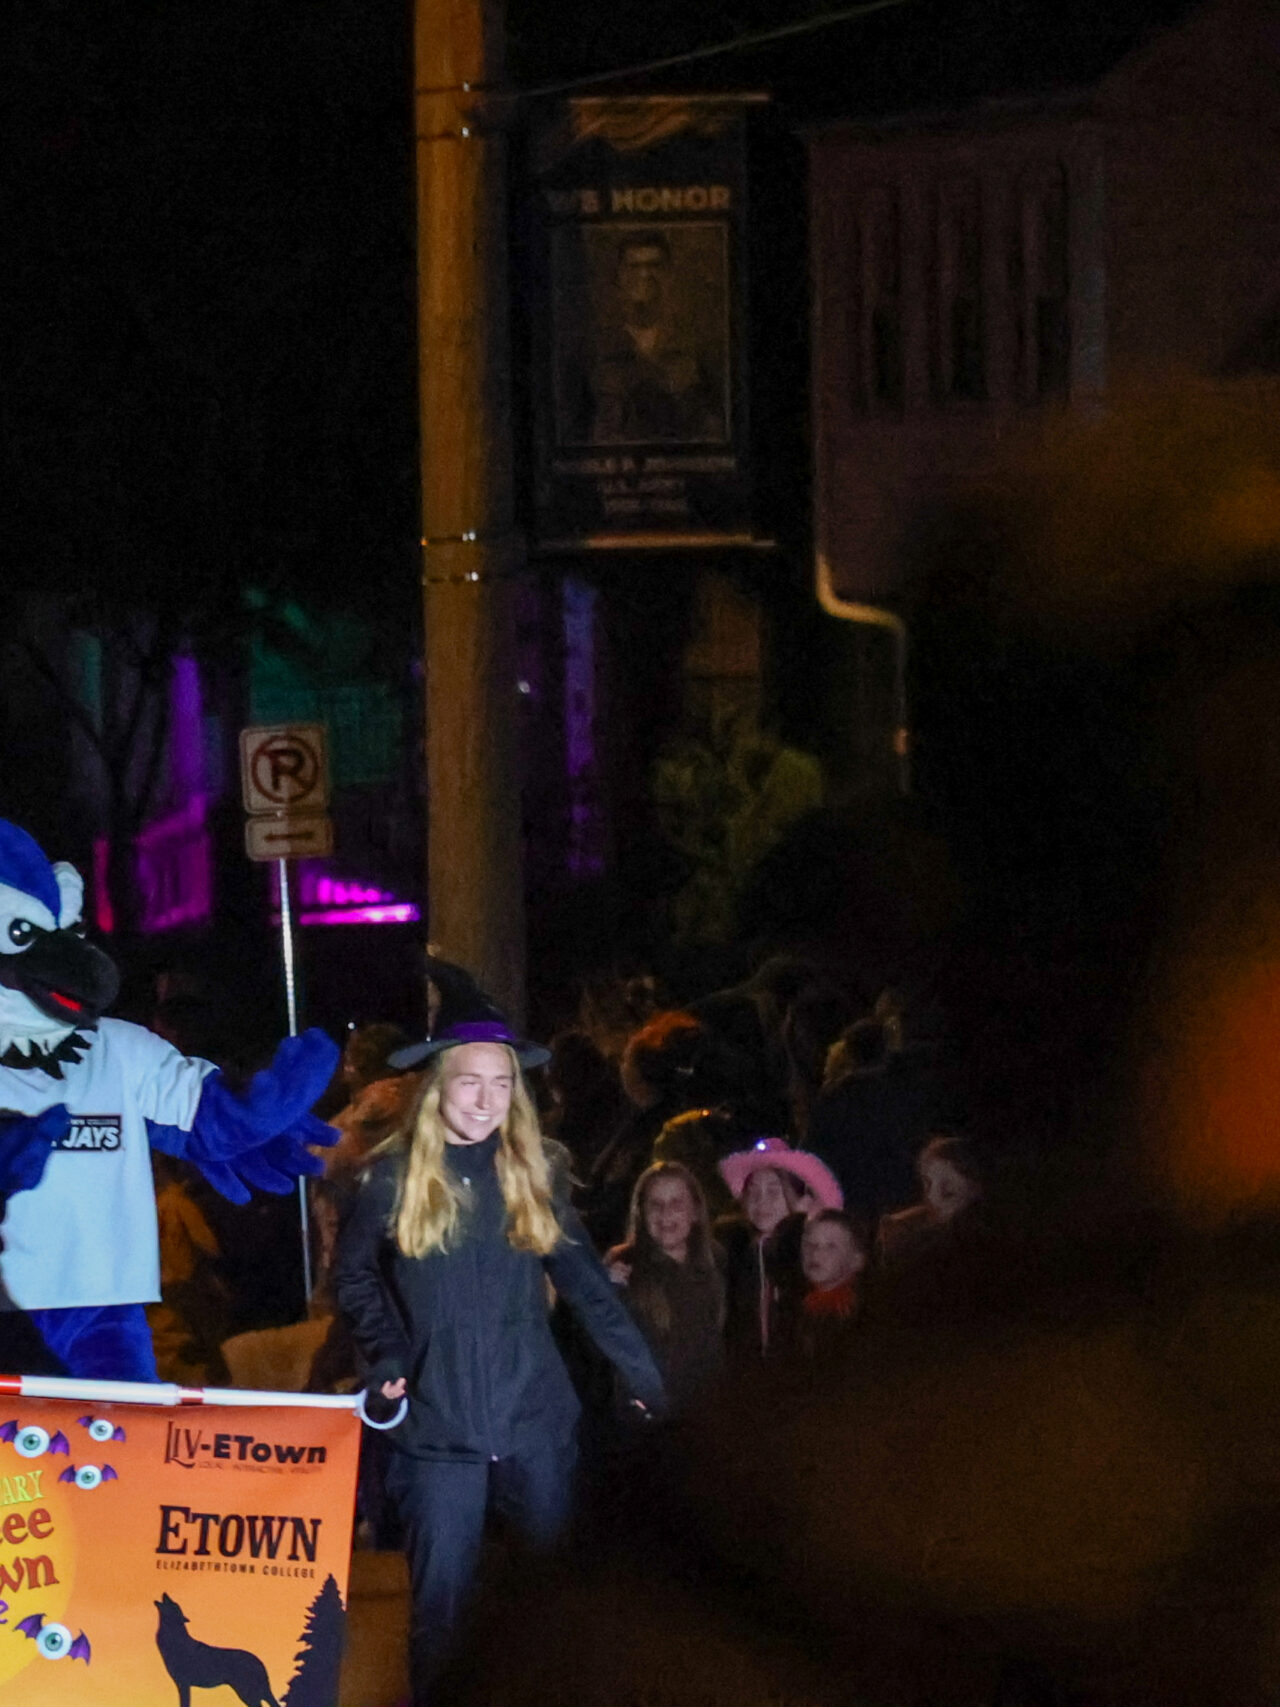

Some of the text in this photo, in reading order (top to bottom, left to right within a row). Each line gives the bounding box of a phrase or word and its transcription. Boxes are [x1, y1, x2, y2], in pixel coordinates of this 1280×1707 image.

[611, 184, 733, 213] HONOR
[61, 1126, 120, 1149] JAYS
[155, 1504, 322, 1563] ETOWN
[156, 1559, 315, 1579] ELIZABETHTOWN COLLEGE
